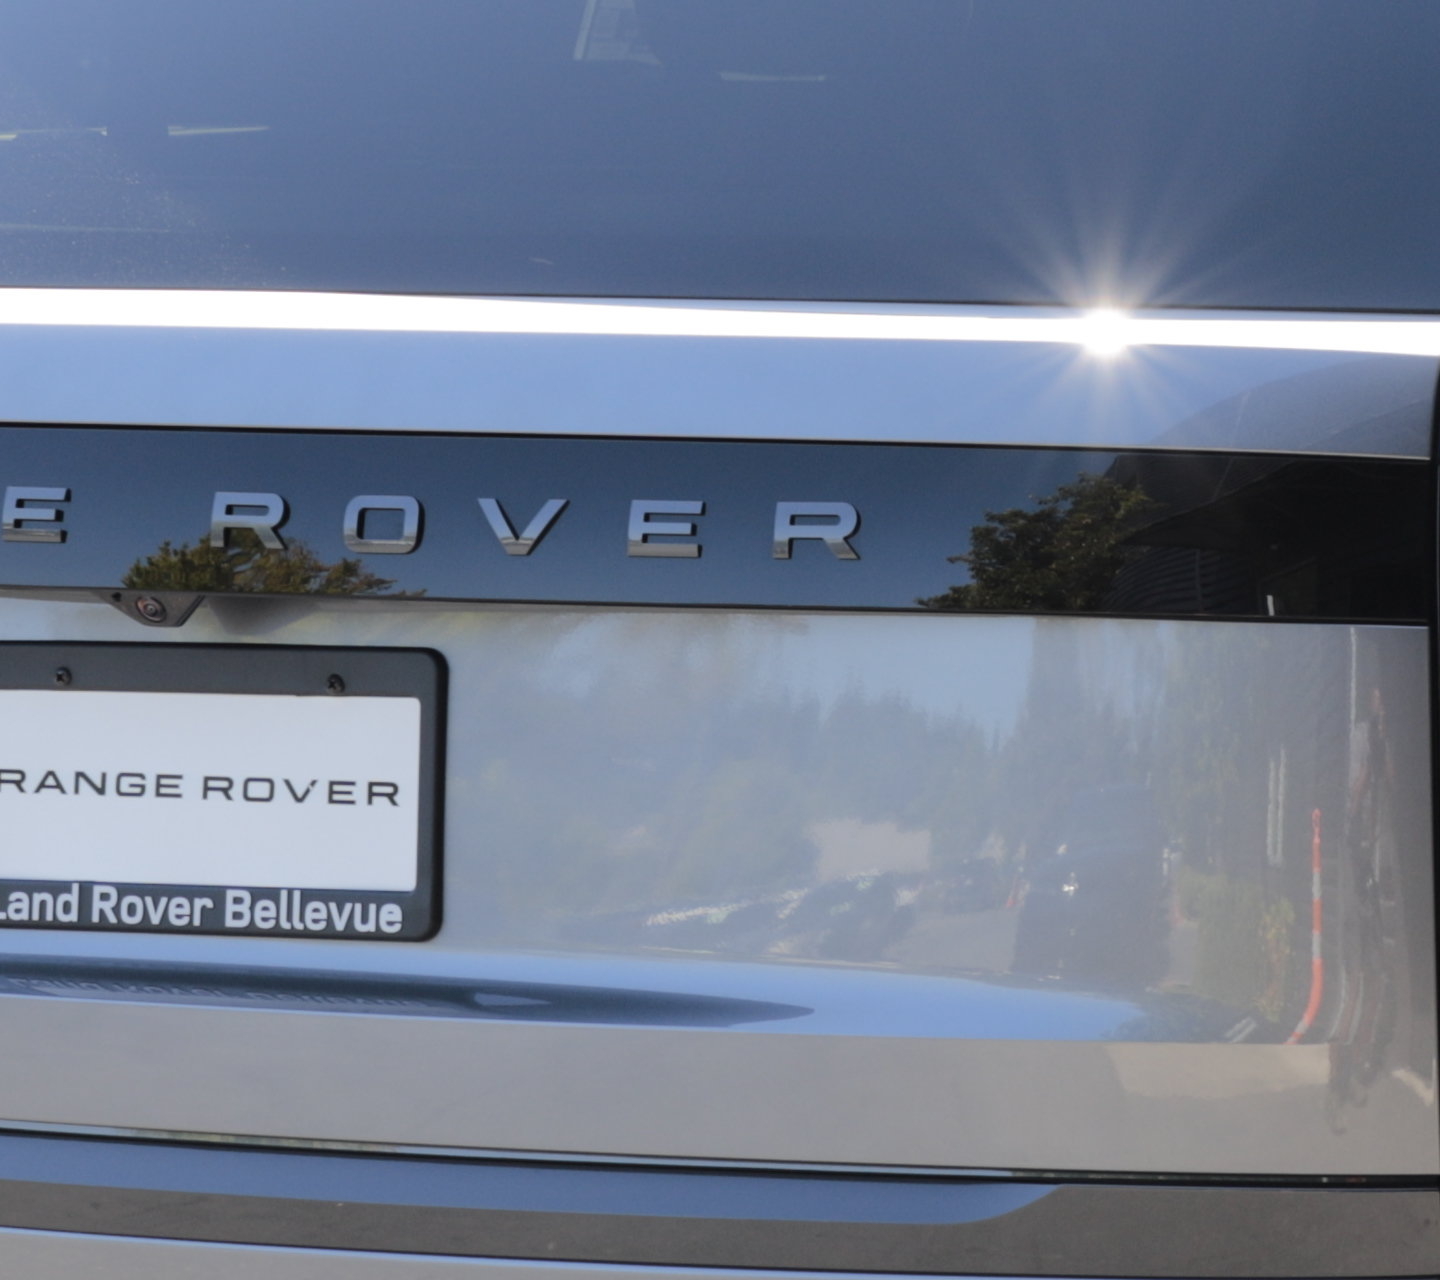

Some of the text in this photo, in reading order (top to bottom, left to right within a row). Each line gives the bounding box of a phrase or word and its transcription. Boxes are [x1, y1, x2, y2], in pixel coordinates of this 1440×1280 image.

[210, 490, 861, 561] ROVER
[202, 776, 401, 807] ROVER
[91, 884, 214, 927] Rover
[224, 889, 404, 934] Bellevue
